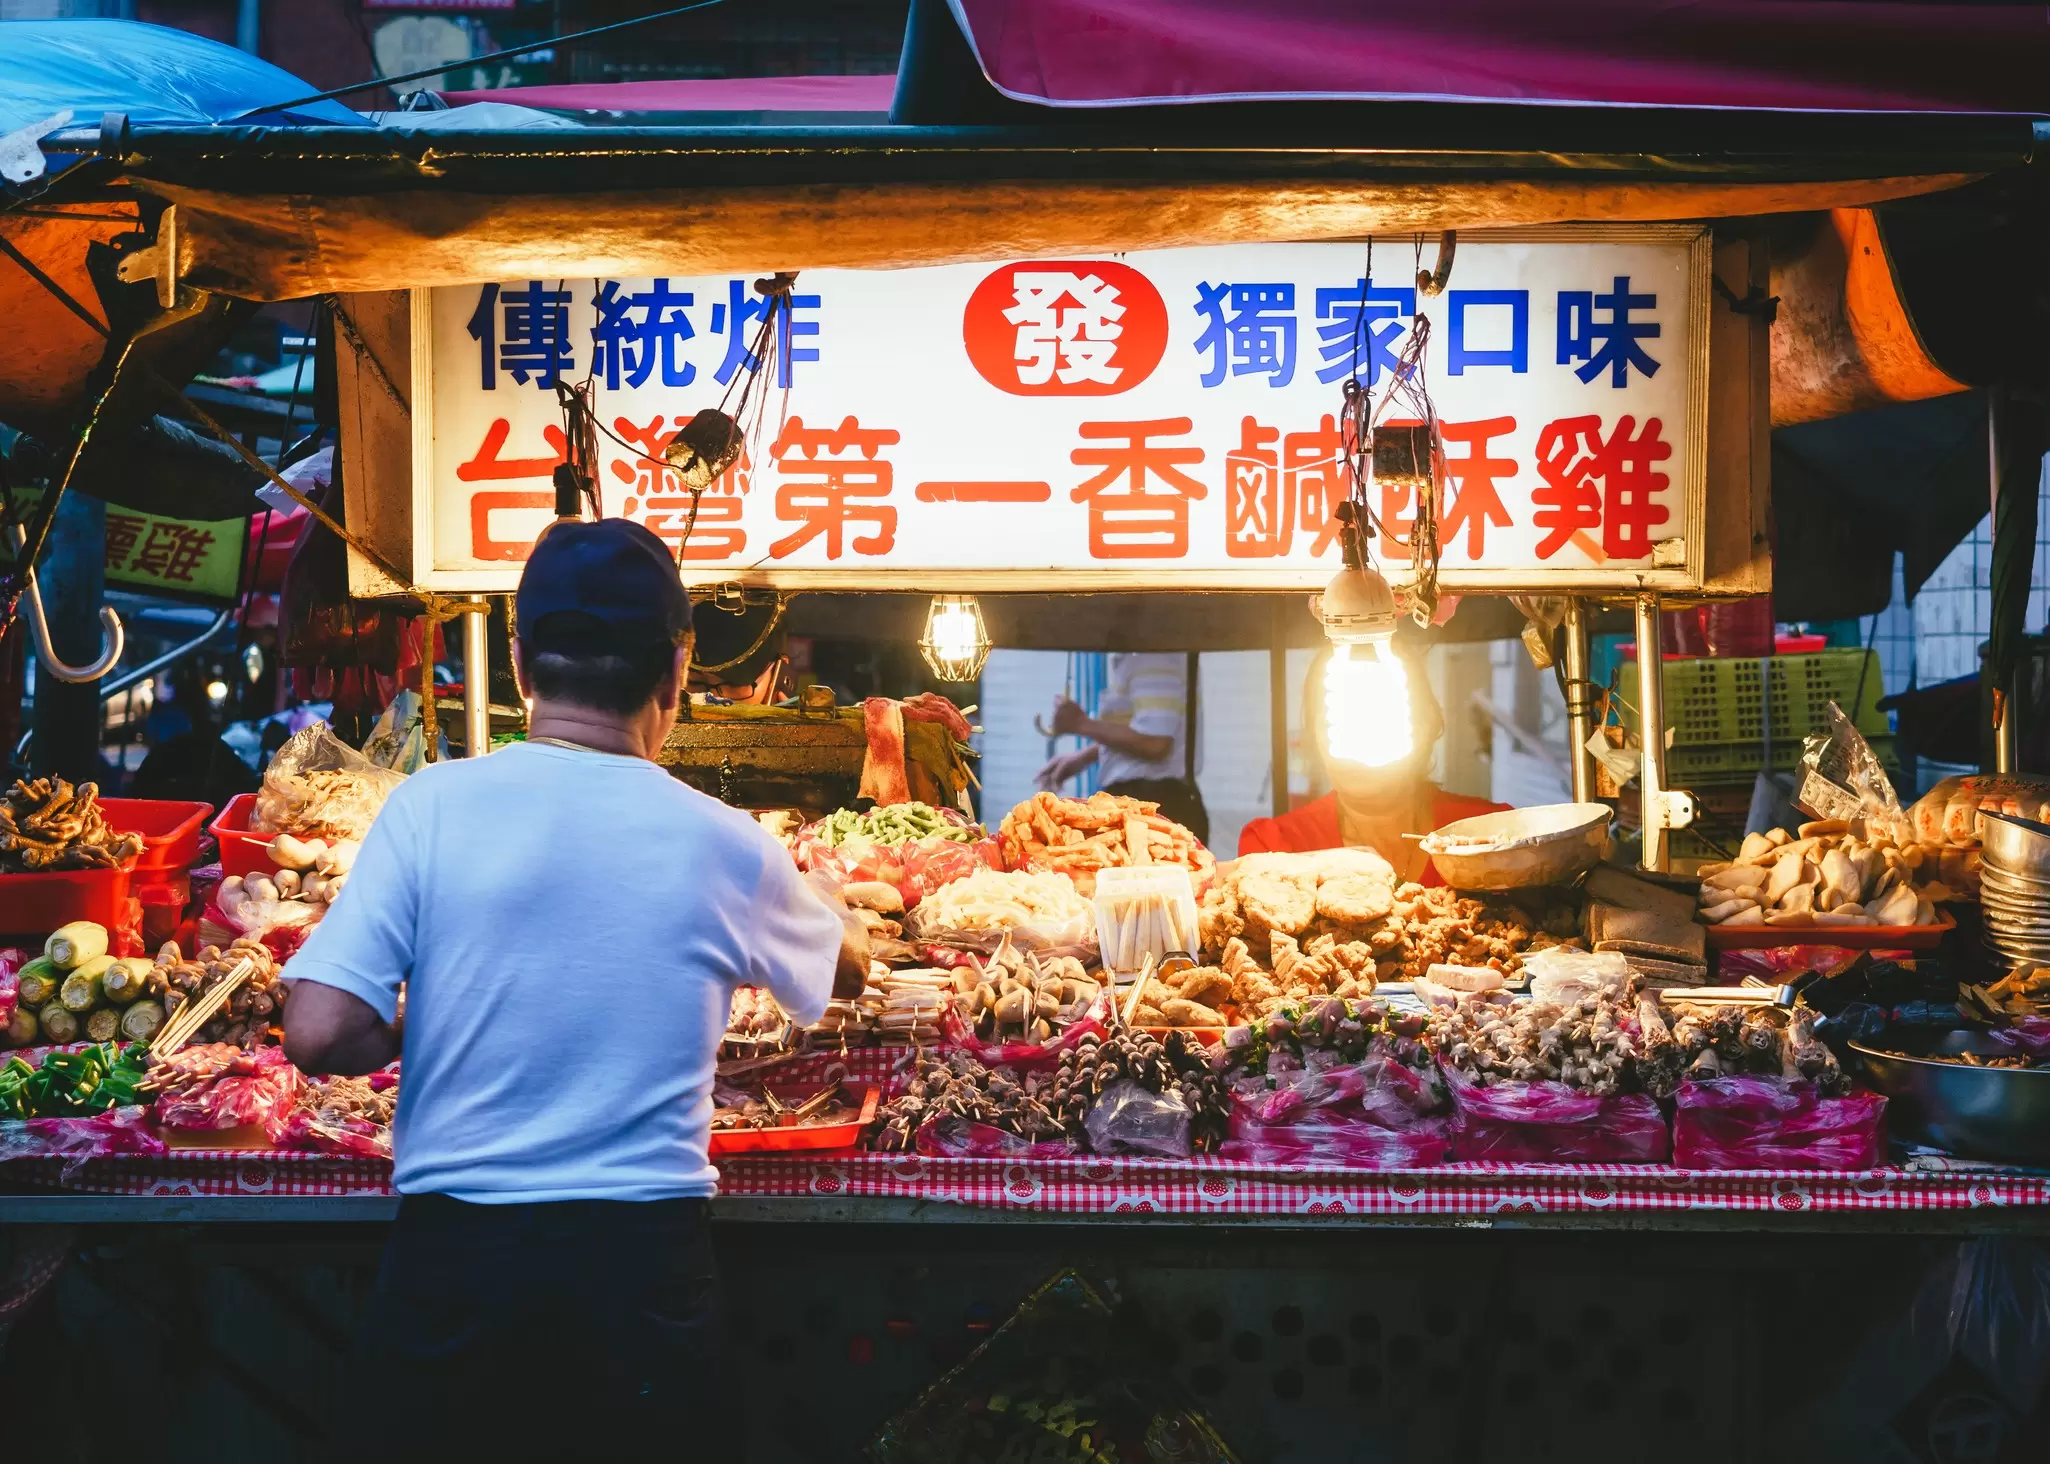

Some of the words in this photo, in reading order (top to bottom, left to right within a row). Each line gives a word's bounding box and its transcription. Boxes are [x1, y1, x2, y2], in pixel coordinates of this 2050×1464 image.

[467, 279, 822, 391] 傳統炸
[1002, 262, 1129, 388] 發
[1193, 276, 1662, 389] 獨家口味
[456, 414, 1673, 561] 台灣第一香鹹酥雞
